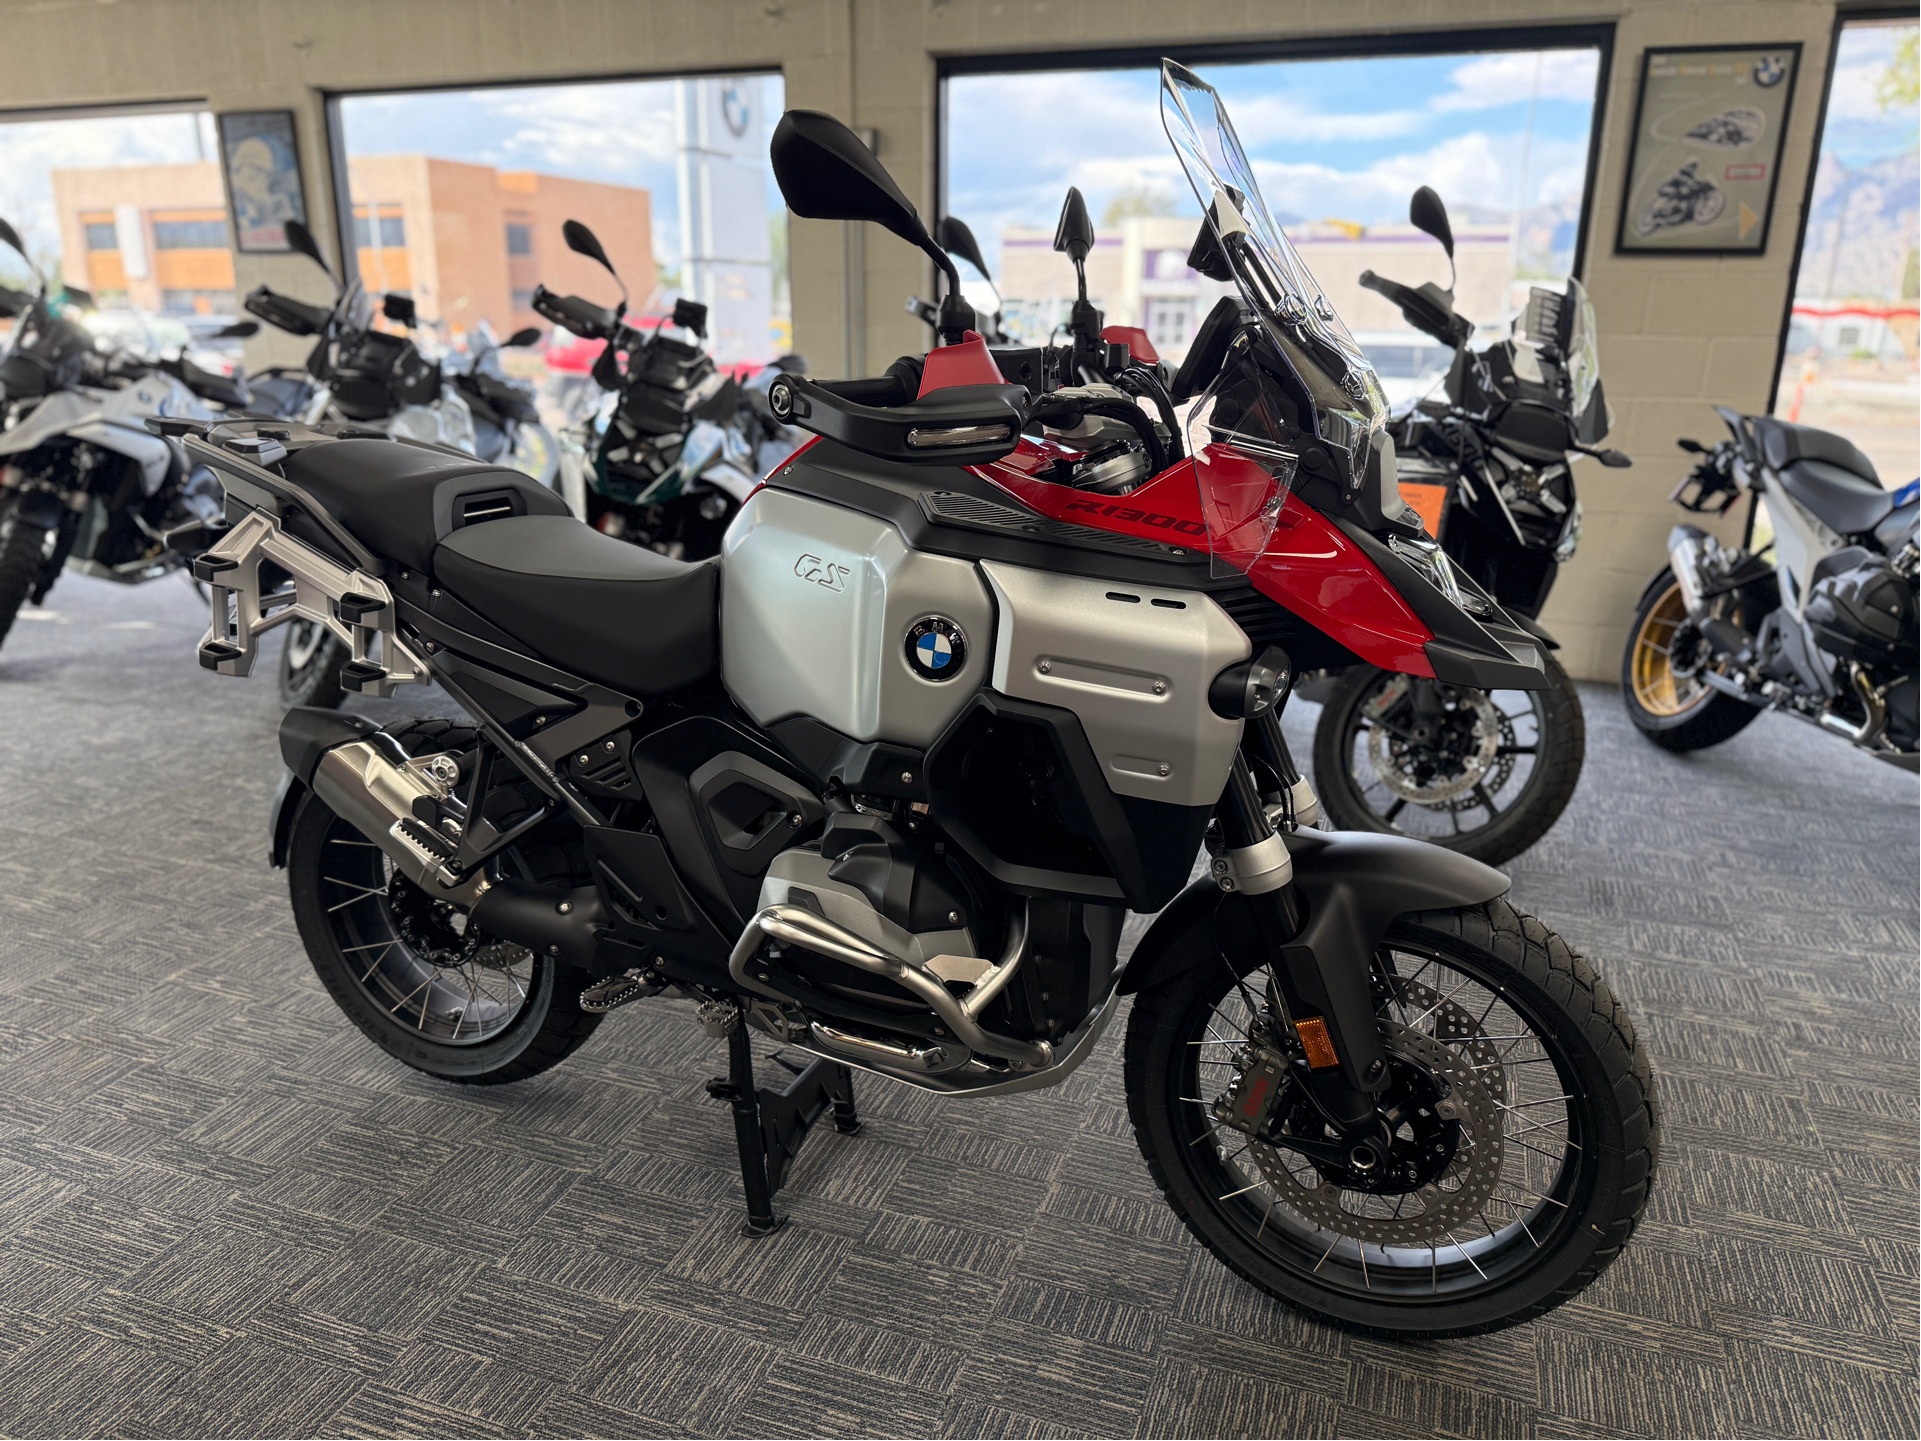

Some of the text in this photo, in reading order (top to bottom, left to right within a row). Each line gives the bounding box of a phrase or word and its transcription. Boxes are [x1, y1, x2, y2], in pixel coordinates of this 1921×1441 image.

[1065, 499, 1208, 536] R1300
[794, 553, 851, 593] GS
[1243, 1076, 1269, 1117] BMW
